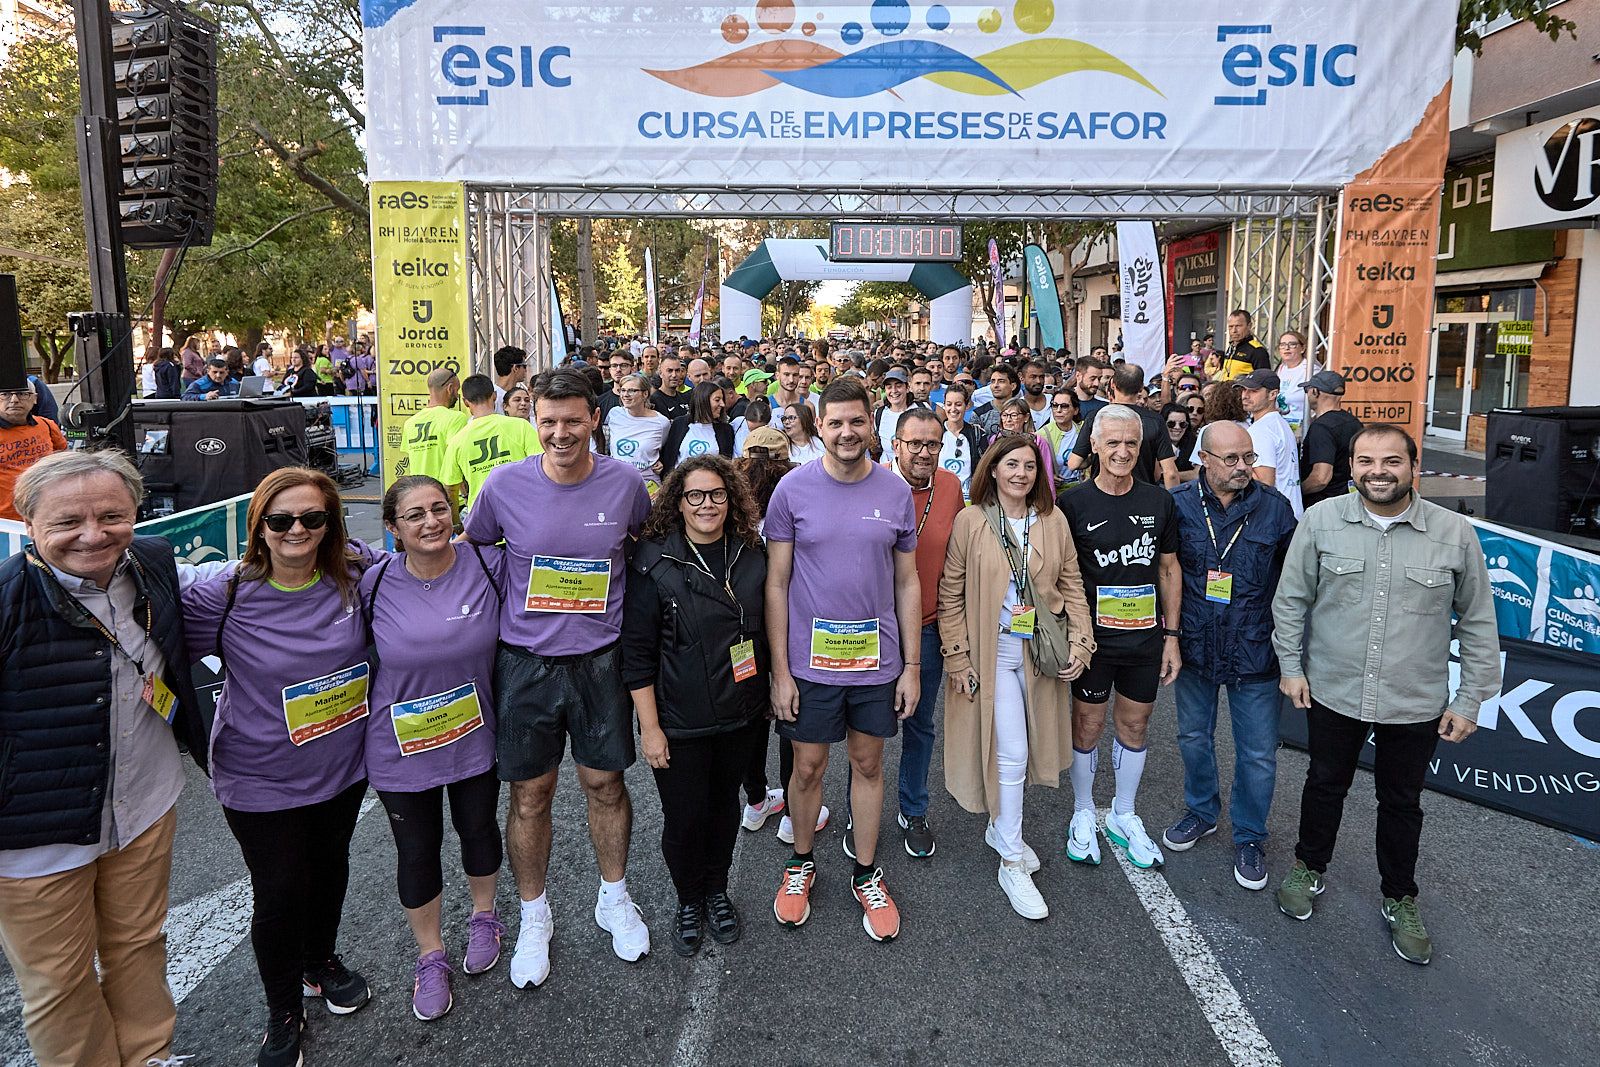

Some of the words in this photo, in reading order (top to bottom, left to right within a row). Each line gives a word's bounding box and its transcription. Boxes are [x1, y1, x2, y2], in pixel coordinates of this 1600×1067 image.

[638, 110, 767, 139] CURSA
[770, 111, 794, 124] DE
[804, 110, 1005, 139] EMPRESES
[1008, 112, 1033, 126] DE
[1036, 111, 1167, 140] SAFOR
[770, 125, 801, 139] LES
[1008, 126, 1031, 140] LA
[377, 191, 429, 210] faes
[1349, 193, 1404, 213] faes
[378, 226, 395, 237] RH
[403, 226, 458, 238] BAYREN
[1371, 229, 1430, 241] BAYREN
[392, 257, 449, 277] teika
[823, 266, 865, 274] FUNDACIÓN
[1184, 251, 1216, 270] VICSAL
[1356, 260, 1415, 281] teika
[1497, 334, 1533, 346] ALQUIL
[397, 398, 430, 411] ALE-
[408, 421, 438, 444] JL
[468, 435, 511, 466] JL
[559, 576, 582, 585] Jesús
[1501, 590, 1532, 609] SAFOR
[1547, 608, 1584, 630] CURSA
[314, 690, 348, 708] Maribel
[426, 711, 448, 724] Inma
[1453, 763, 1600, 794] VENDING
